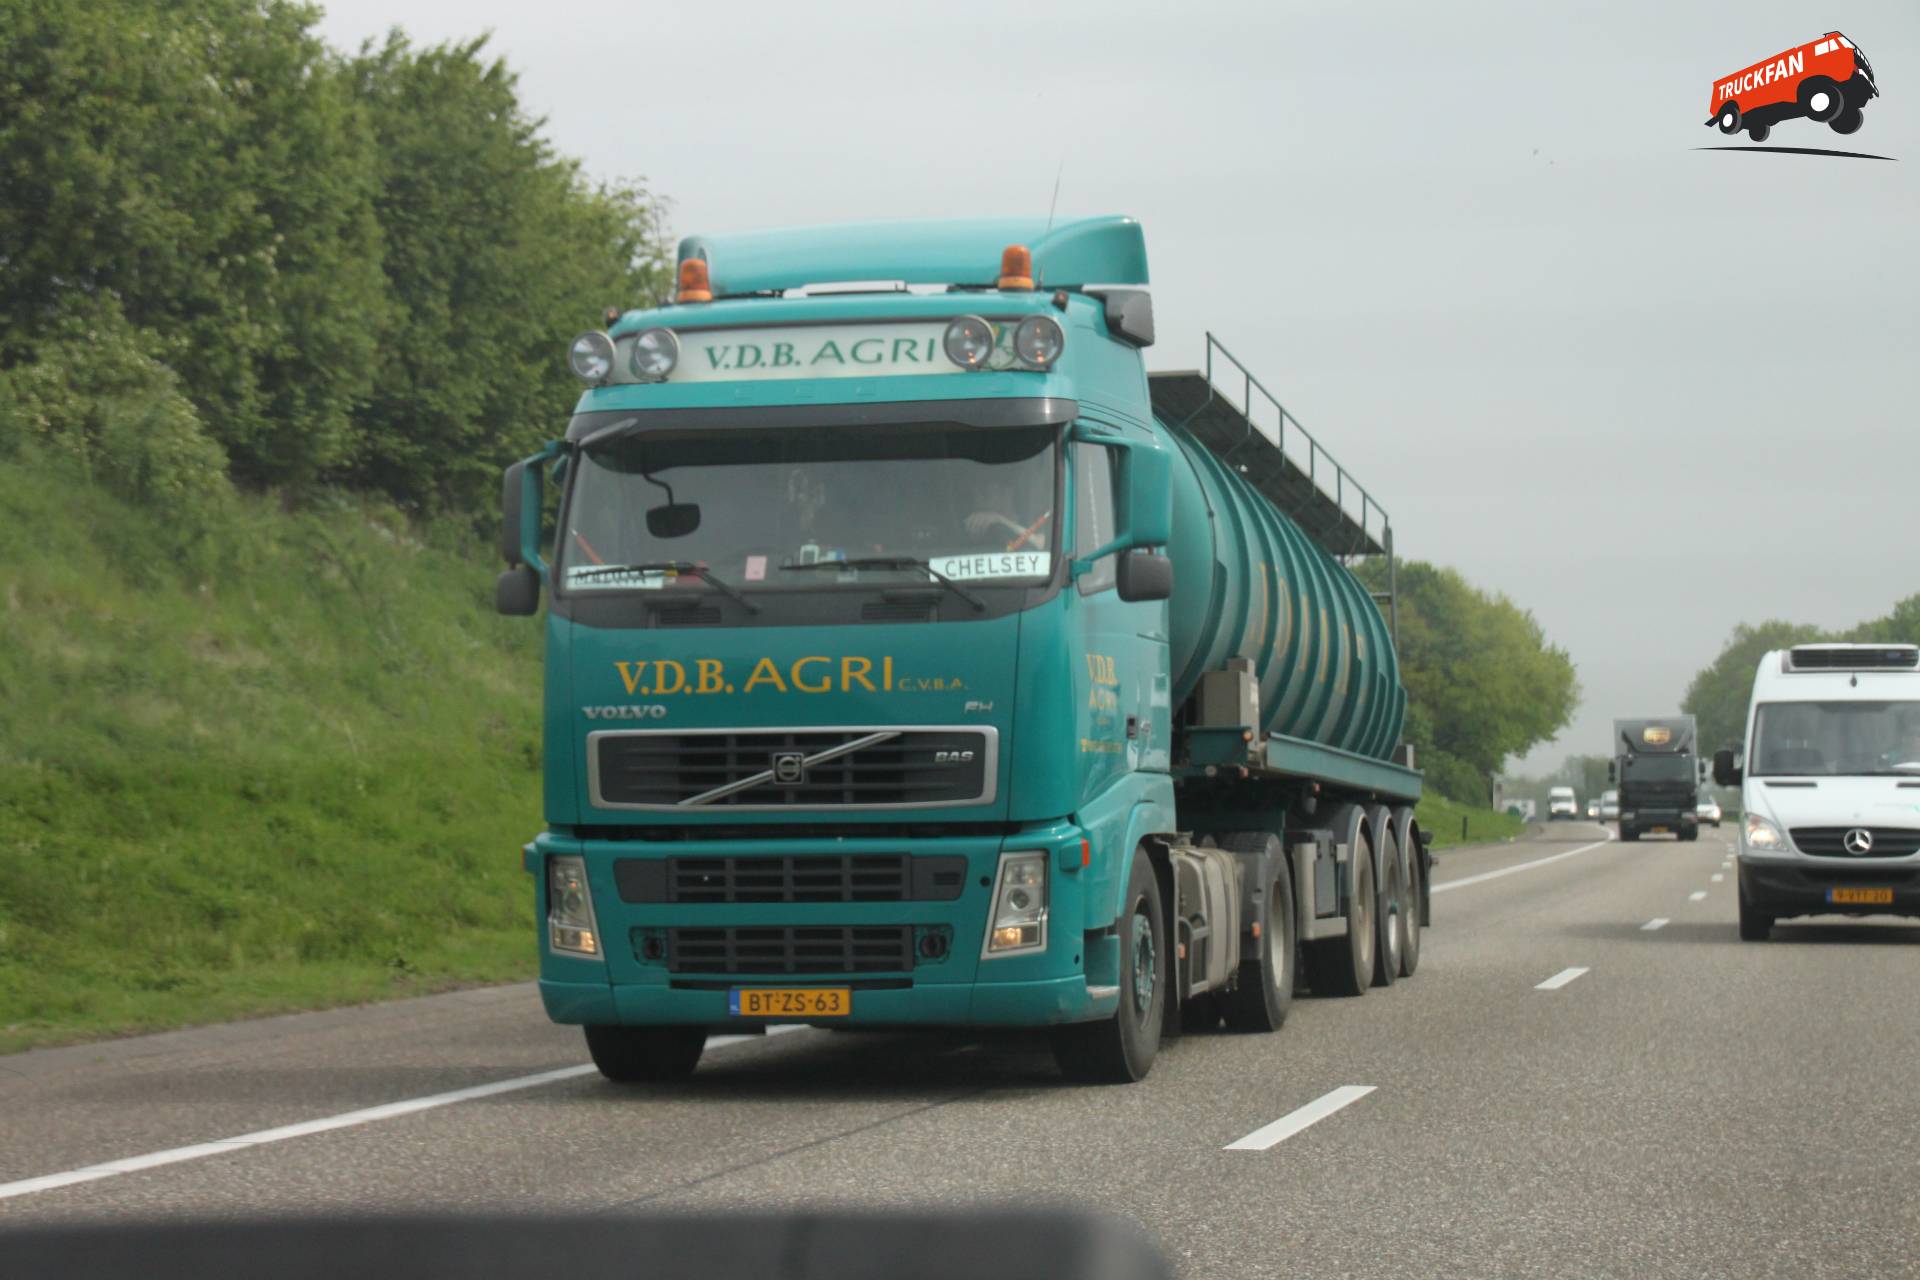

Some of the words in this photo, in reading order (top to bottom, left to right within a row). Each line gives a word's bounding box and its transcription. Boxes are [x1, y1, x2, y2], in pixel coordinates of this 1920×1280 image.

[704, 343, 802, 370] V.D.B.
[810, 338, 935, 366] AGRI
[944, 555, 1039, 577] CHELSEY
[614, 659, 734, 695] V.D.B.
[743, 656, 894, 694] AGRI
[582, 704, 667, 720] VOLVO
[964, 700, 993, 713] FH
[748, 992, 840, 1012] BT-ZS-63
